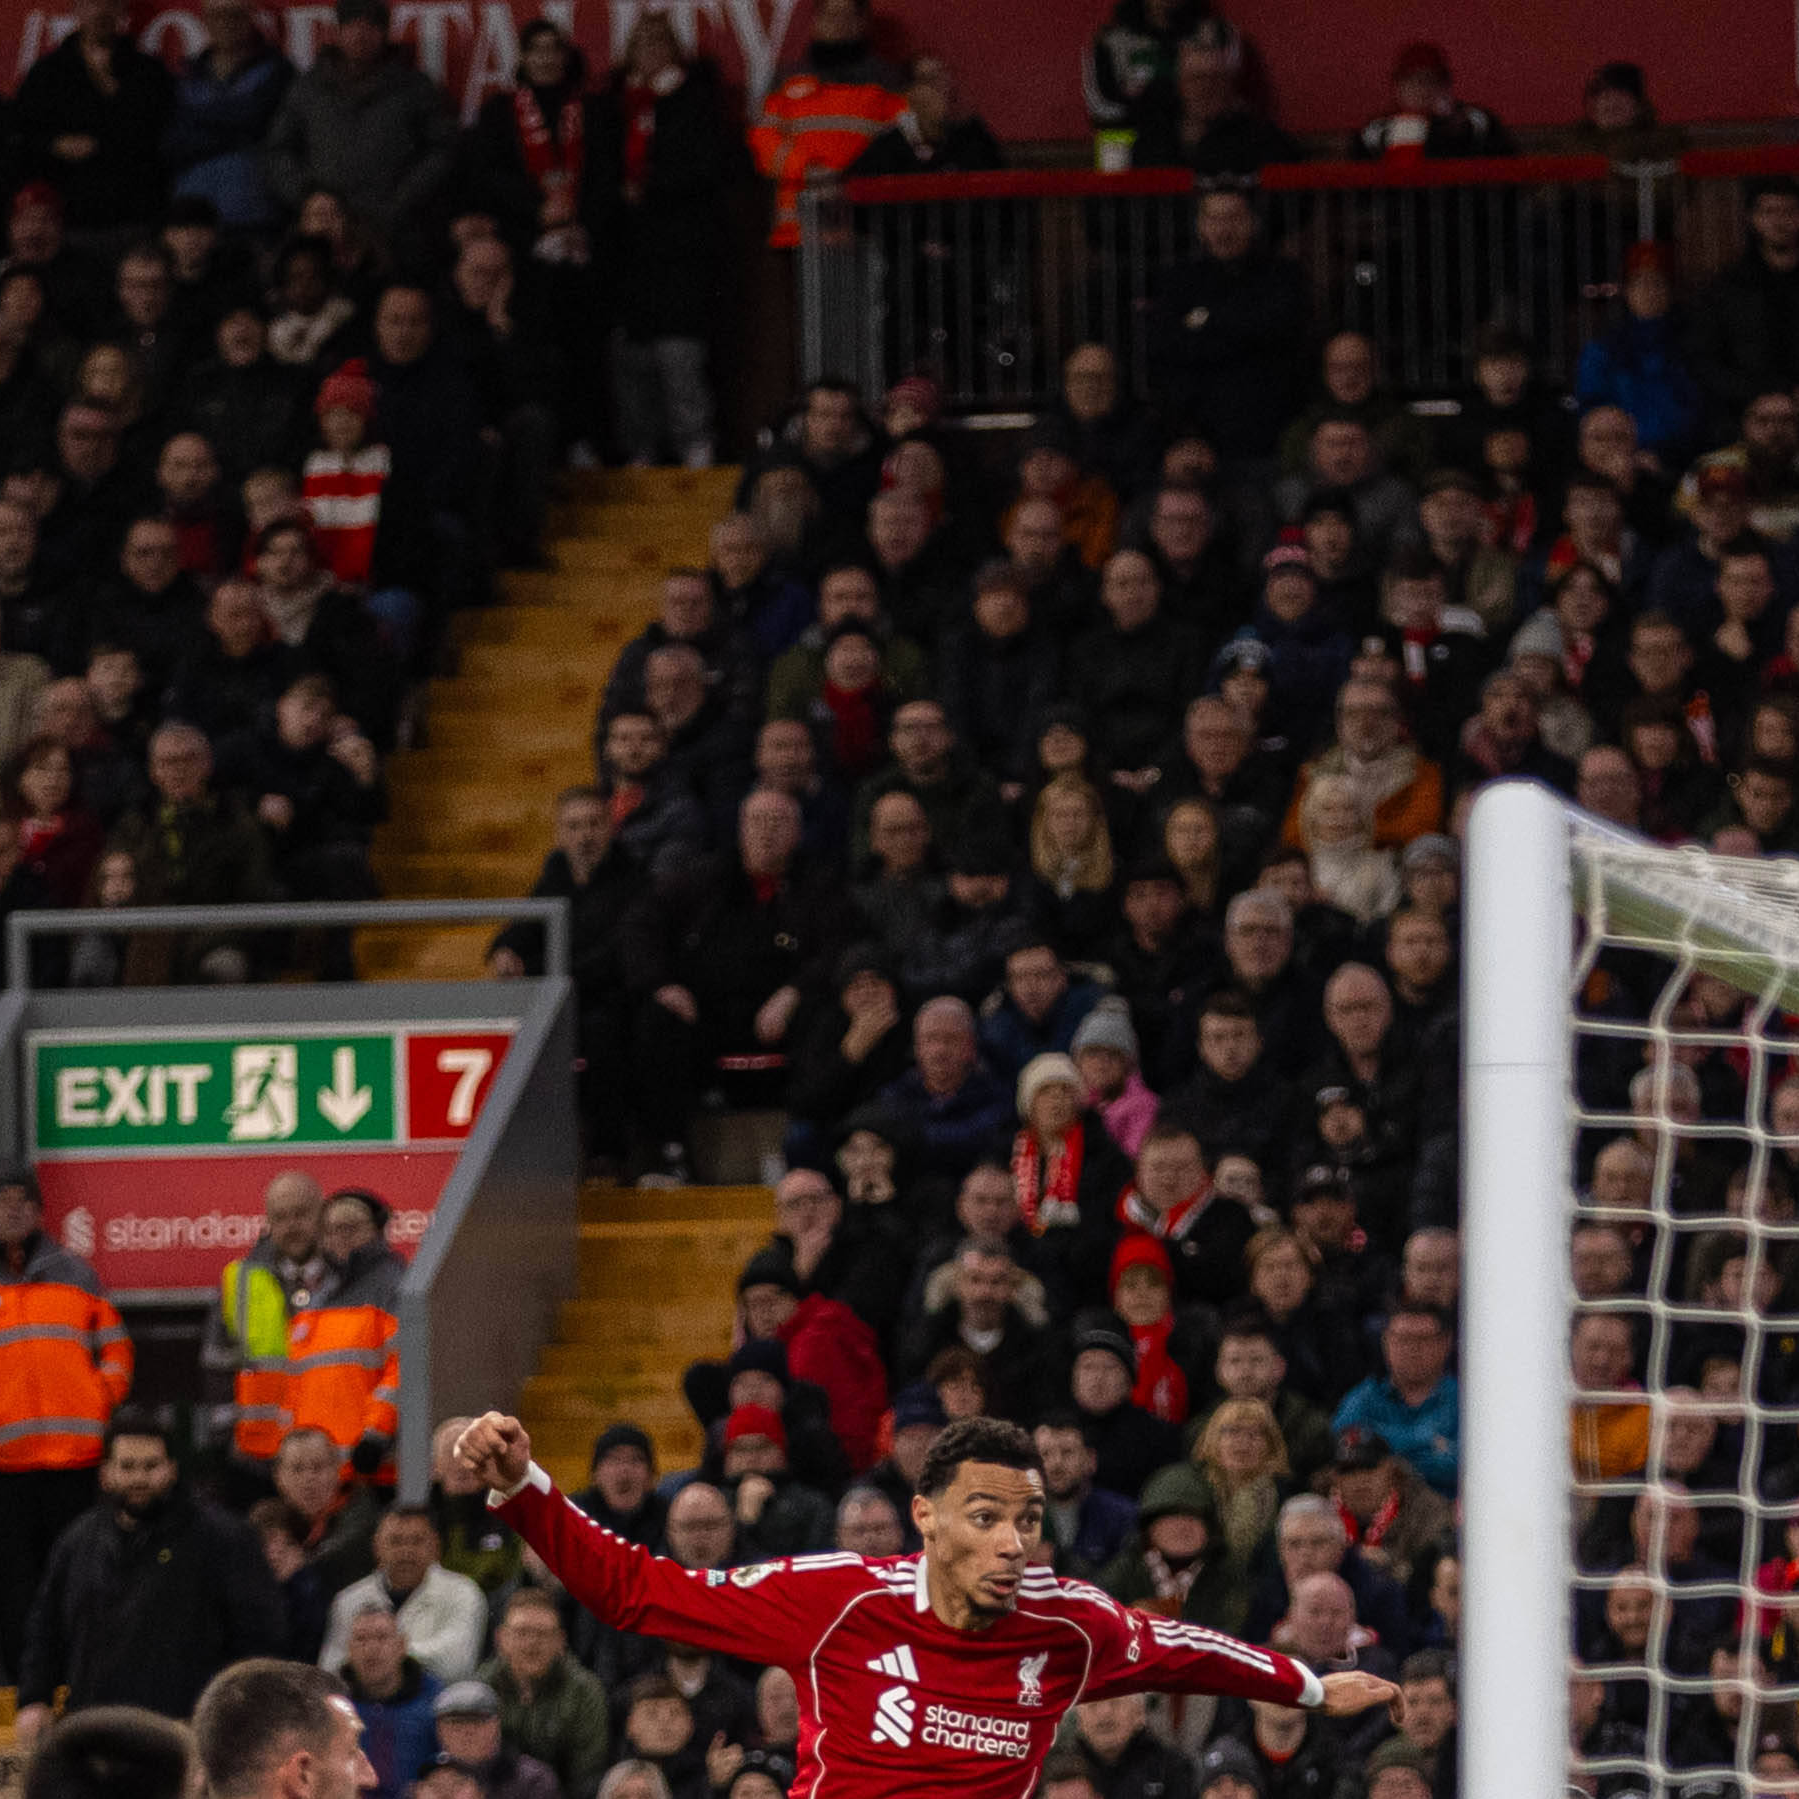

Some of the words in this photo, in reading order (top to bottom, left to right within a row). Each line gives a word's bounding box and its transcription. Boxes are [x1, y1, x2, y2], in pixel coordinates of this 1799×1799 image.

[56, 1062, 212, 1128] EXIT
[437, 1048, 492, 1126] 7
[921, 1725, 1031, 1759] chartered
[924, 1704, 1030, 1740] standard
